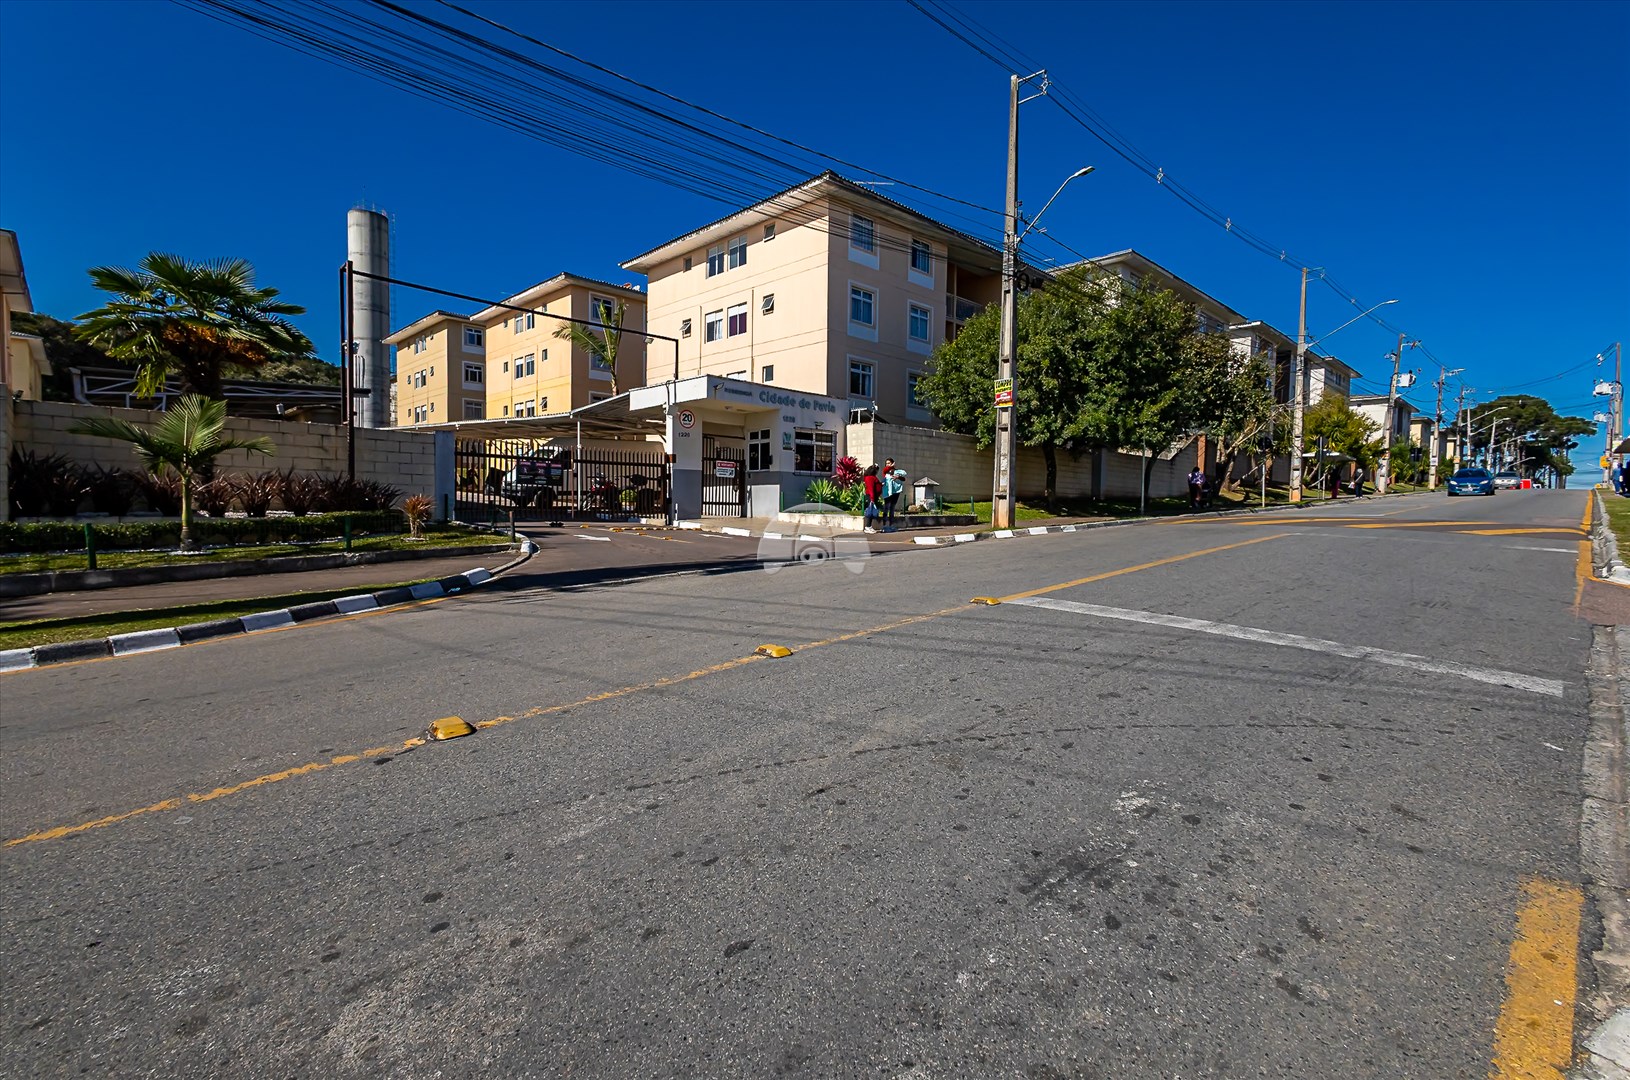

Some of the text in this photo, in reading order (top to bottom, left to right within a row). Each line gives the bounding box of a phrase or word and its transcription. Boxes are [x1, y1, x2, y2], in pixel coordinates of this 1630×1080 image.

[759, 390, 796, 407] Cidade
[798, 398, 811, 409] de
[813, 399, 836, 413] Pavia
[682, 413, 692, 422] 20
